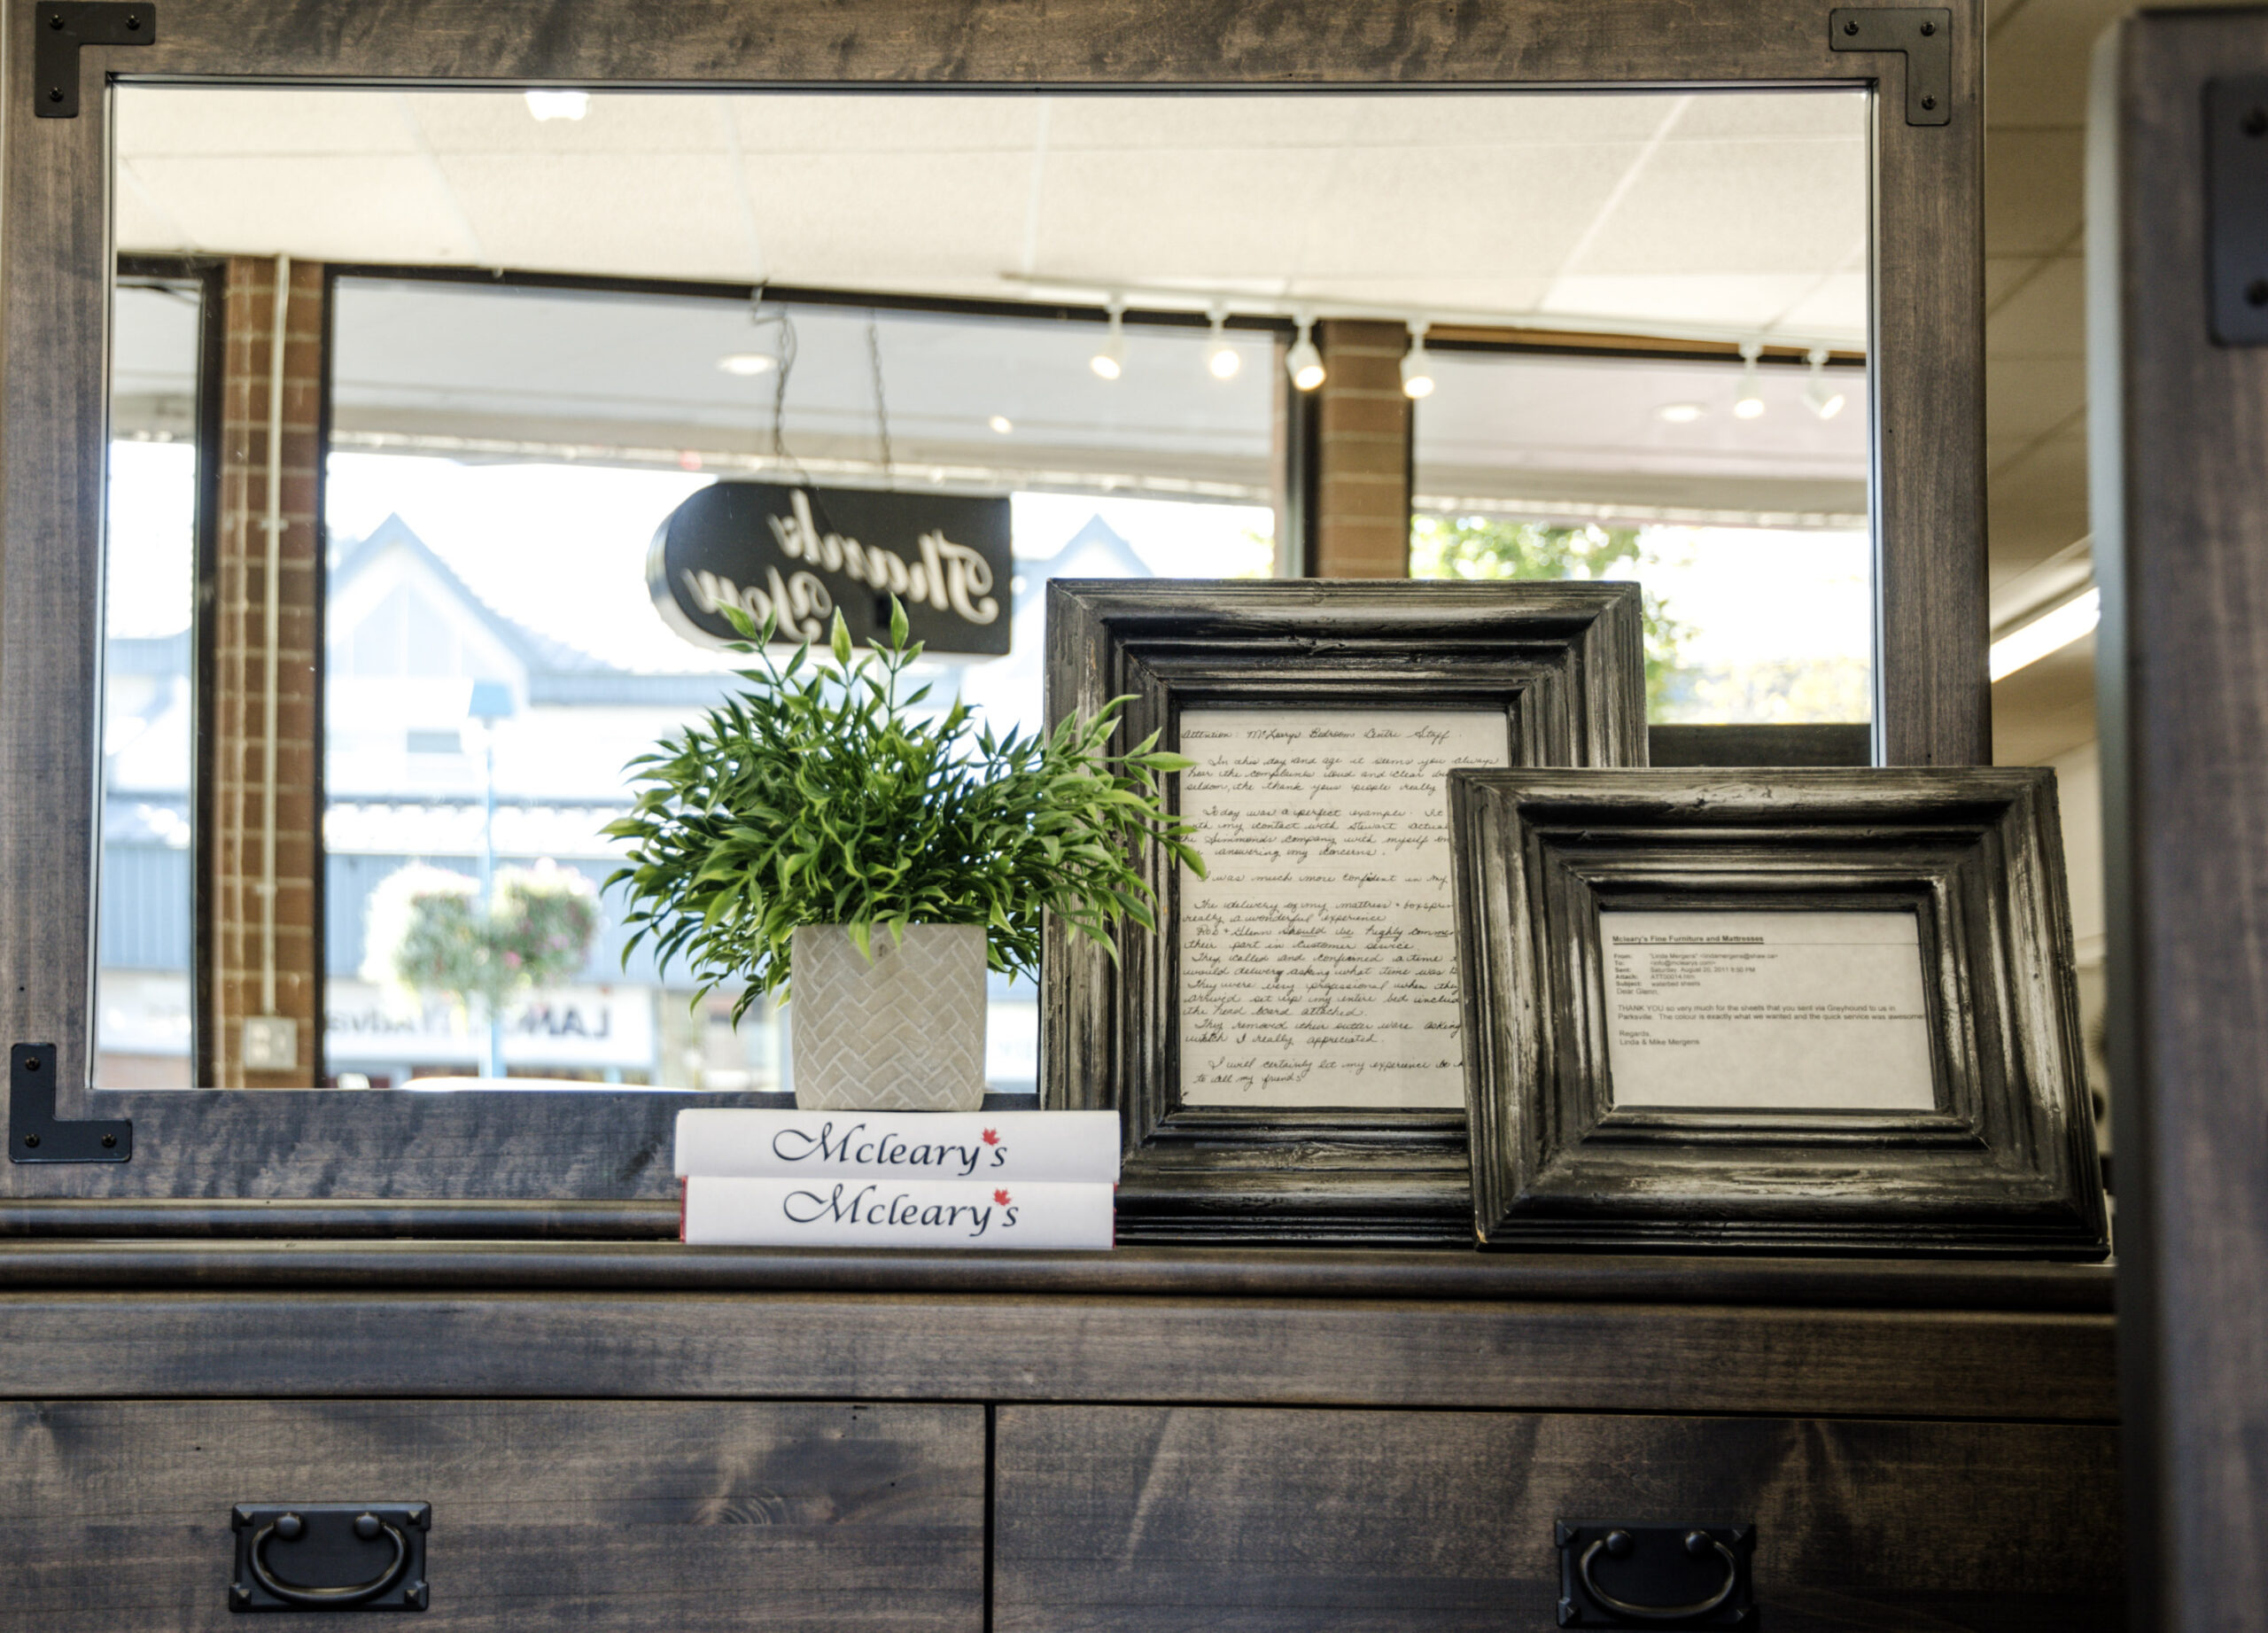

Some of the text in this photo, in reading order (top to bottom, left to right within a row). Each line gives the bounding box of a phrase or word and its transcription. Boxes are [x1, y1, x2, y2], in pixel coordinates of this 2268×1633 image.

[1309, 727, 1355, 738] Bedroom
[1208, 754, 1228, 766] In
[1234, 756, 1259, 766] this
[1263, 757, 1285, 770] day
[1323, 758, 1341, 769] age
[1418, 758, 1445, 772] you
[1452, 756, 1498, 766] always
[1188, 766, 1213, 777] hear
[1219, 769, 1240, 778] the
[1392, 769, 1425, 778] clear
[1233, 782, 1254, 790] the
[1262, 781, 1303, 790] thank
[1400, 783, 1436, 797] really
[1293, 808, 1341, 820] perfect
[1218, 823, 1245, 836] my
[1304, 820, 1338, 829] with
[1281, 835, 1337, 849] company
[1382, 835, 1430, 851] myself
[1286, 850, 1308, 864] my
[1251, 873, 1292, 883] much
[1426, 875, 1448, 890] my
[1194, 899, 1391, 916] The delivery of my mattress
[1183, 914, 1224, 928] really
[1245, 914, 1310, 927] wonderful
[1321, 913, 1386, 924] experience
[1278, 927, 1326, 937] should
[1365, 924, 1402, 943] highly
[1184, 938, 1216, 949] their
[1230, 940, 1261, 951] part
[1265, 938, 1284, 949] in
[1230, 953, 1269, 963] called
[1406, 953, 1442, 962] time
[1287, 964, 1329, 982] asking
[1335, 965, 1371, 975] what
[1379, 967, 1410, 976] time
[1188, 979, 1217, 996] They
[1262, 984, 1294, 995] very
[1394, 979, 1426, 989] when
[1278, 995, 1302, 1005] up
[1309, 996, 1332, 1007] my
[1338, 994, 1377, 1003] entire
[1383, 993, 1409, 1003] bed
[1184, 1006, 1208, 1015] the
[1195, 1019, 1223, 1035] They
[1231, 1021, 1287, 1030] removed
[1295, 1020, 1328, 1030] their
[1237, 1033, 1293, 1050] I really
[1227, 1057, 1256, 1069] will
[1262, 1058, 1312, 1077] certainly
[1318, 1059, 1336, 1069] let
[1342, 1061, 1364, 1076] my
[1193, 1072, 1301, 1092] to all my friends
